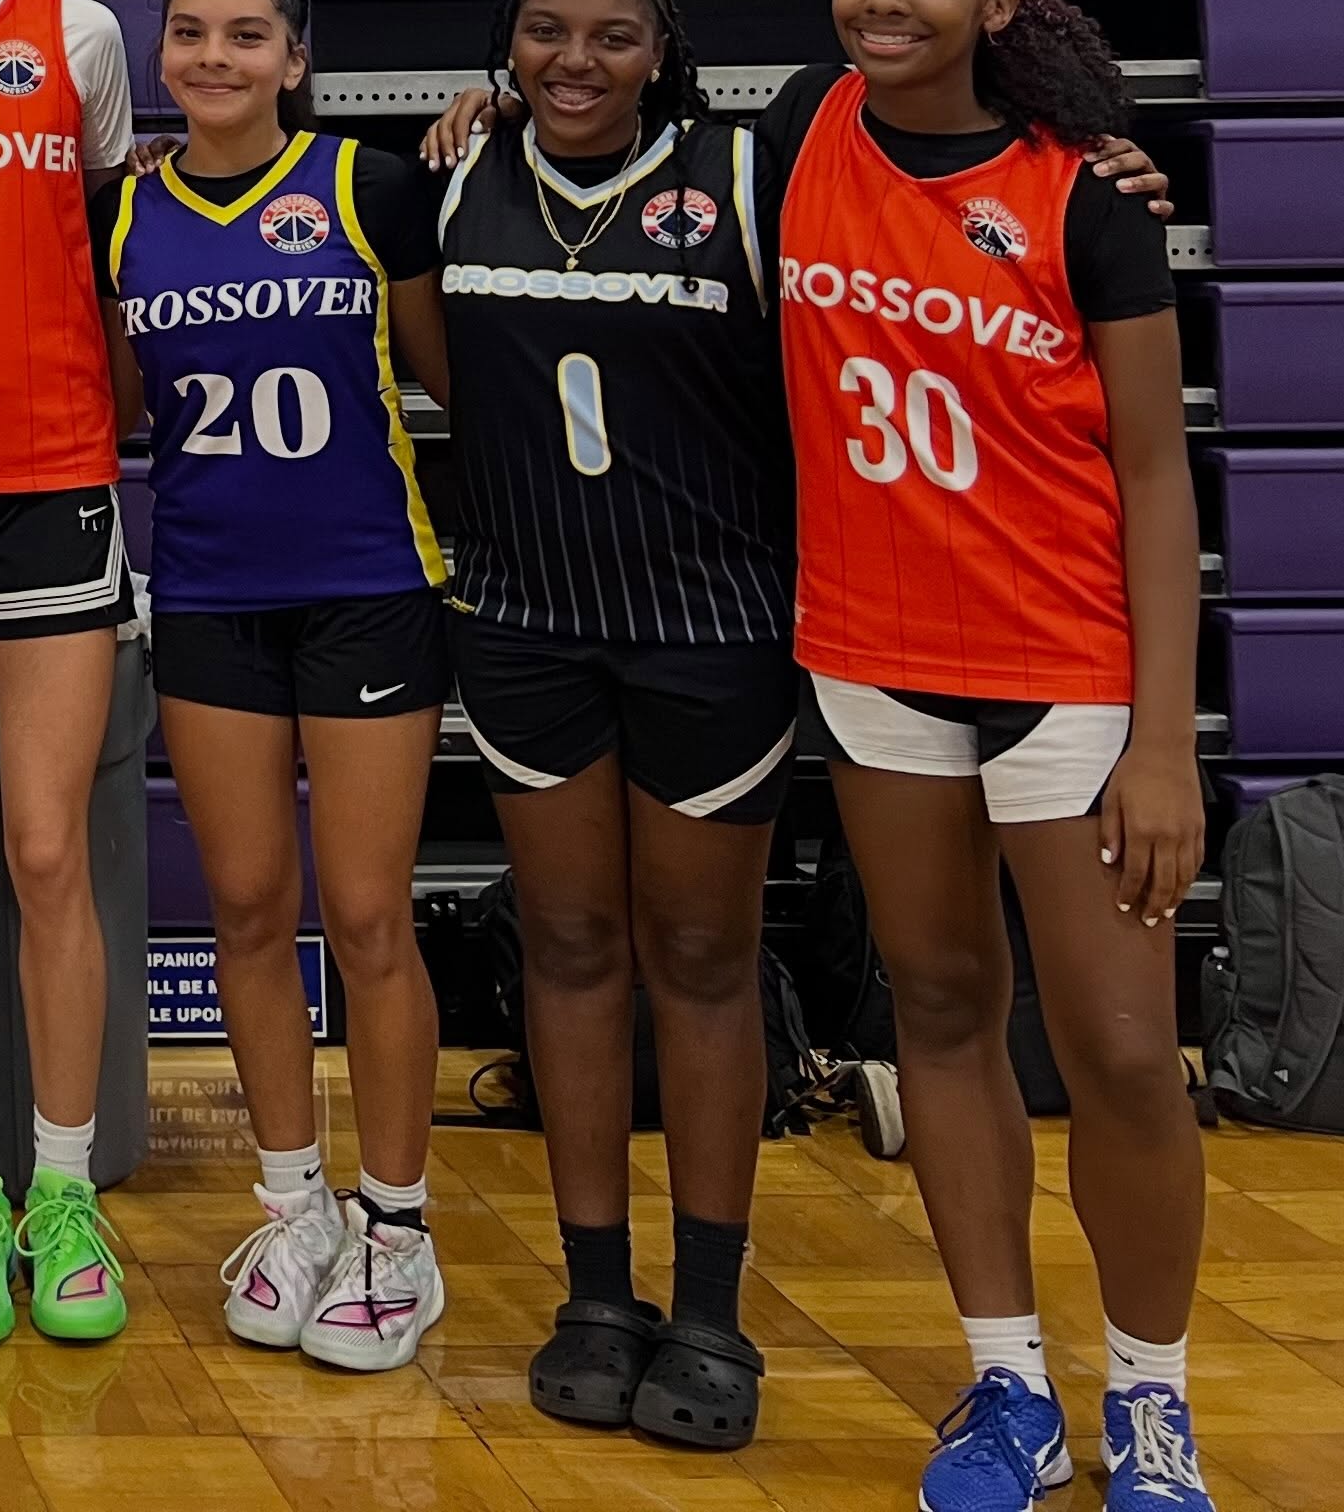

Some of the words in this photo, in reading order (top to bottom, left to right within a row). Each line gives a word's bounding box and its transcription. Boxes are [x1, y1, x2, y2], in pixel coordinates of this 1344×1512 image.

[779, 256, 1065, 363] ROSSOVER
[173, 367, 331, 458] 20
[840, 357, 978, 492] 30
[147, 980, 174, 995] ILL
[179, 980, 203, 995] BE
